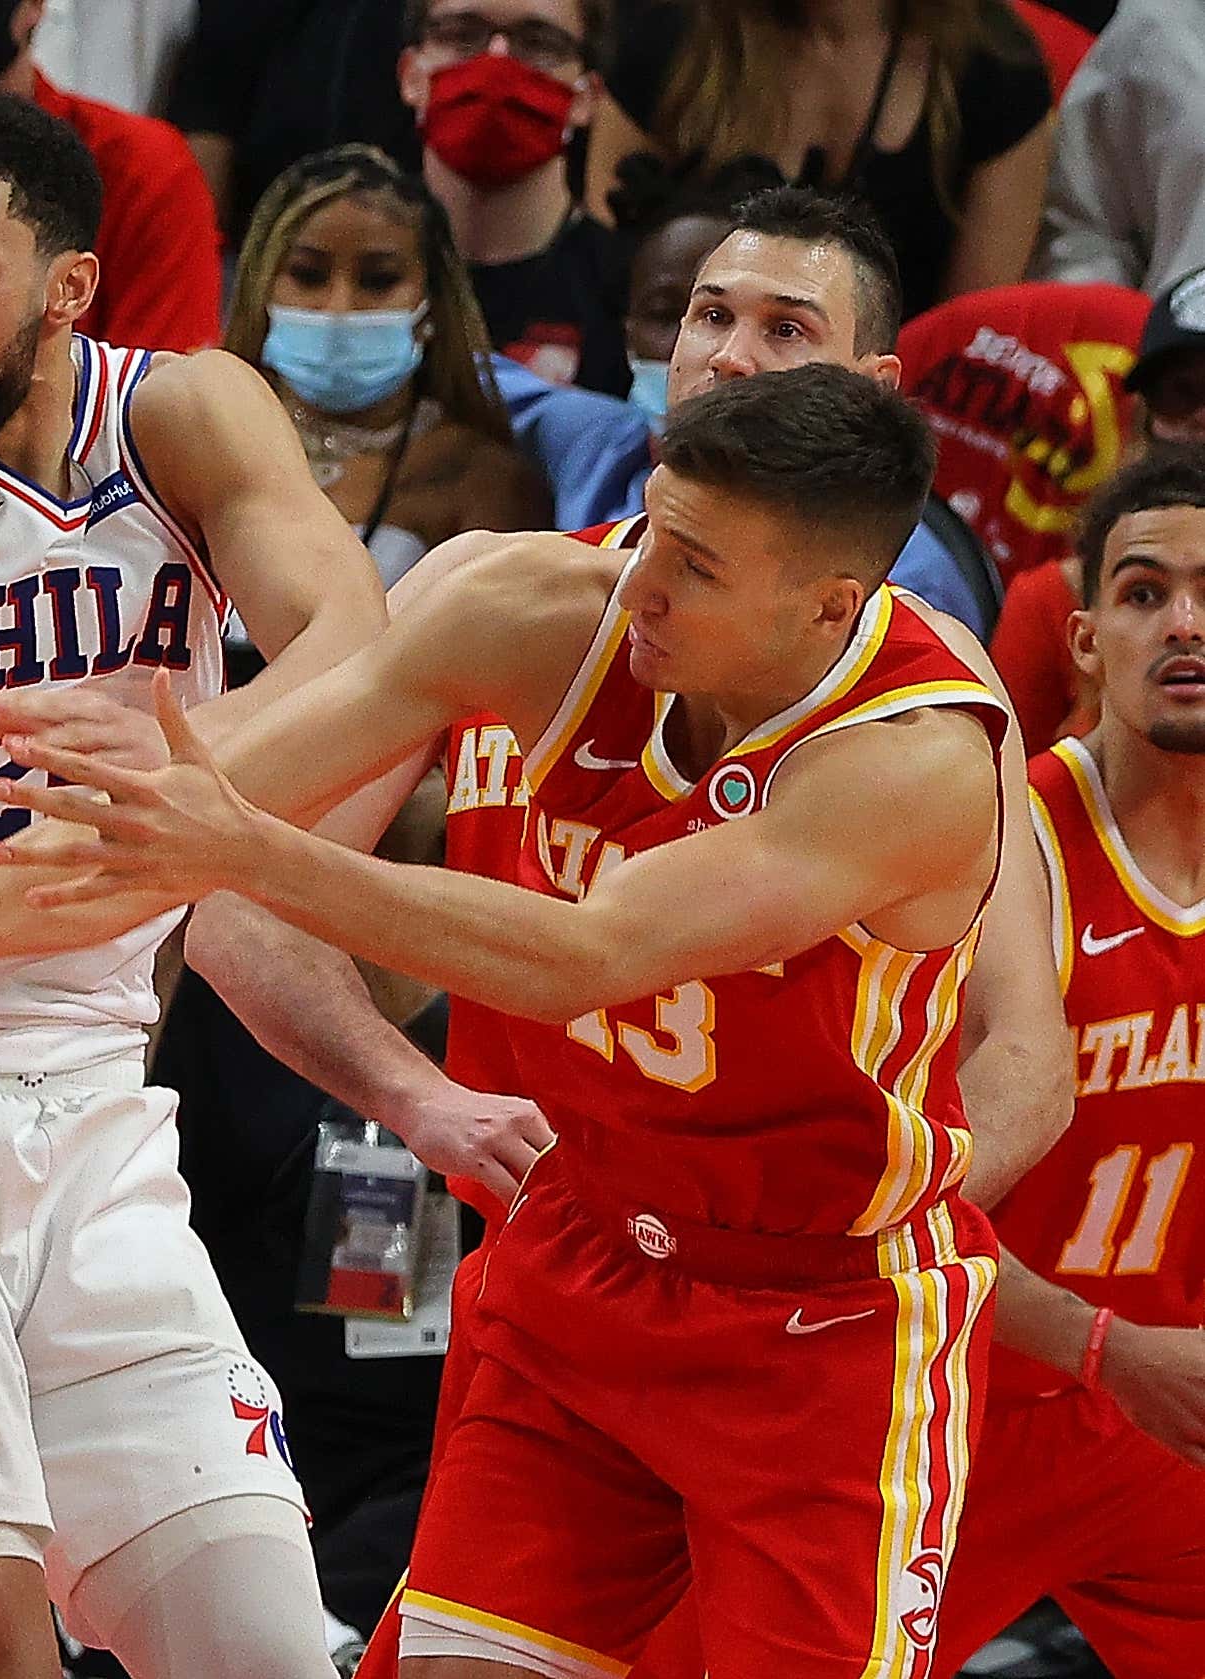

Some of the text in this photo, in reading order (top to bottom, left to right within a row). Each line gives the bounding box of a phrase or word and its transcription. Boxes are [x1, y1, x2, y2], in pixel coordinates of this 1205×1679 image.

[446, 725, 534, 815] AT
[1075, 1003, 1205, 1097] TLA
[627, 1217, 677, 1255] HAWKS
[1055, 1142, 1194, 1277] 11
